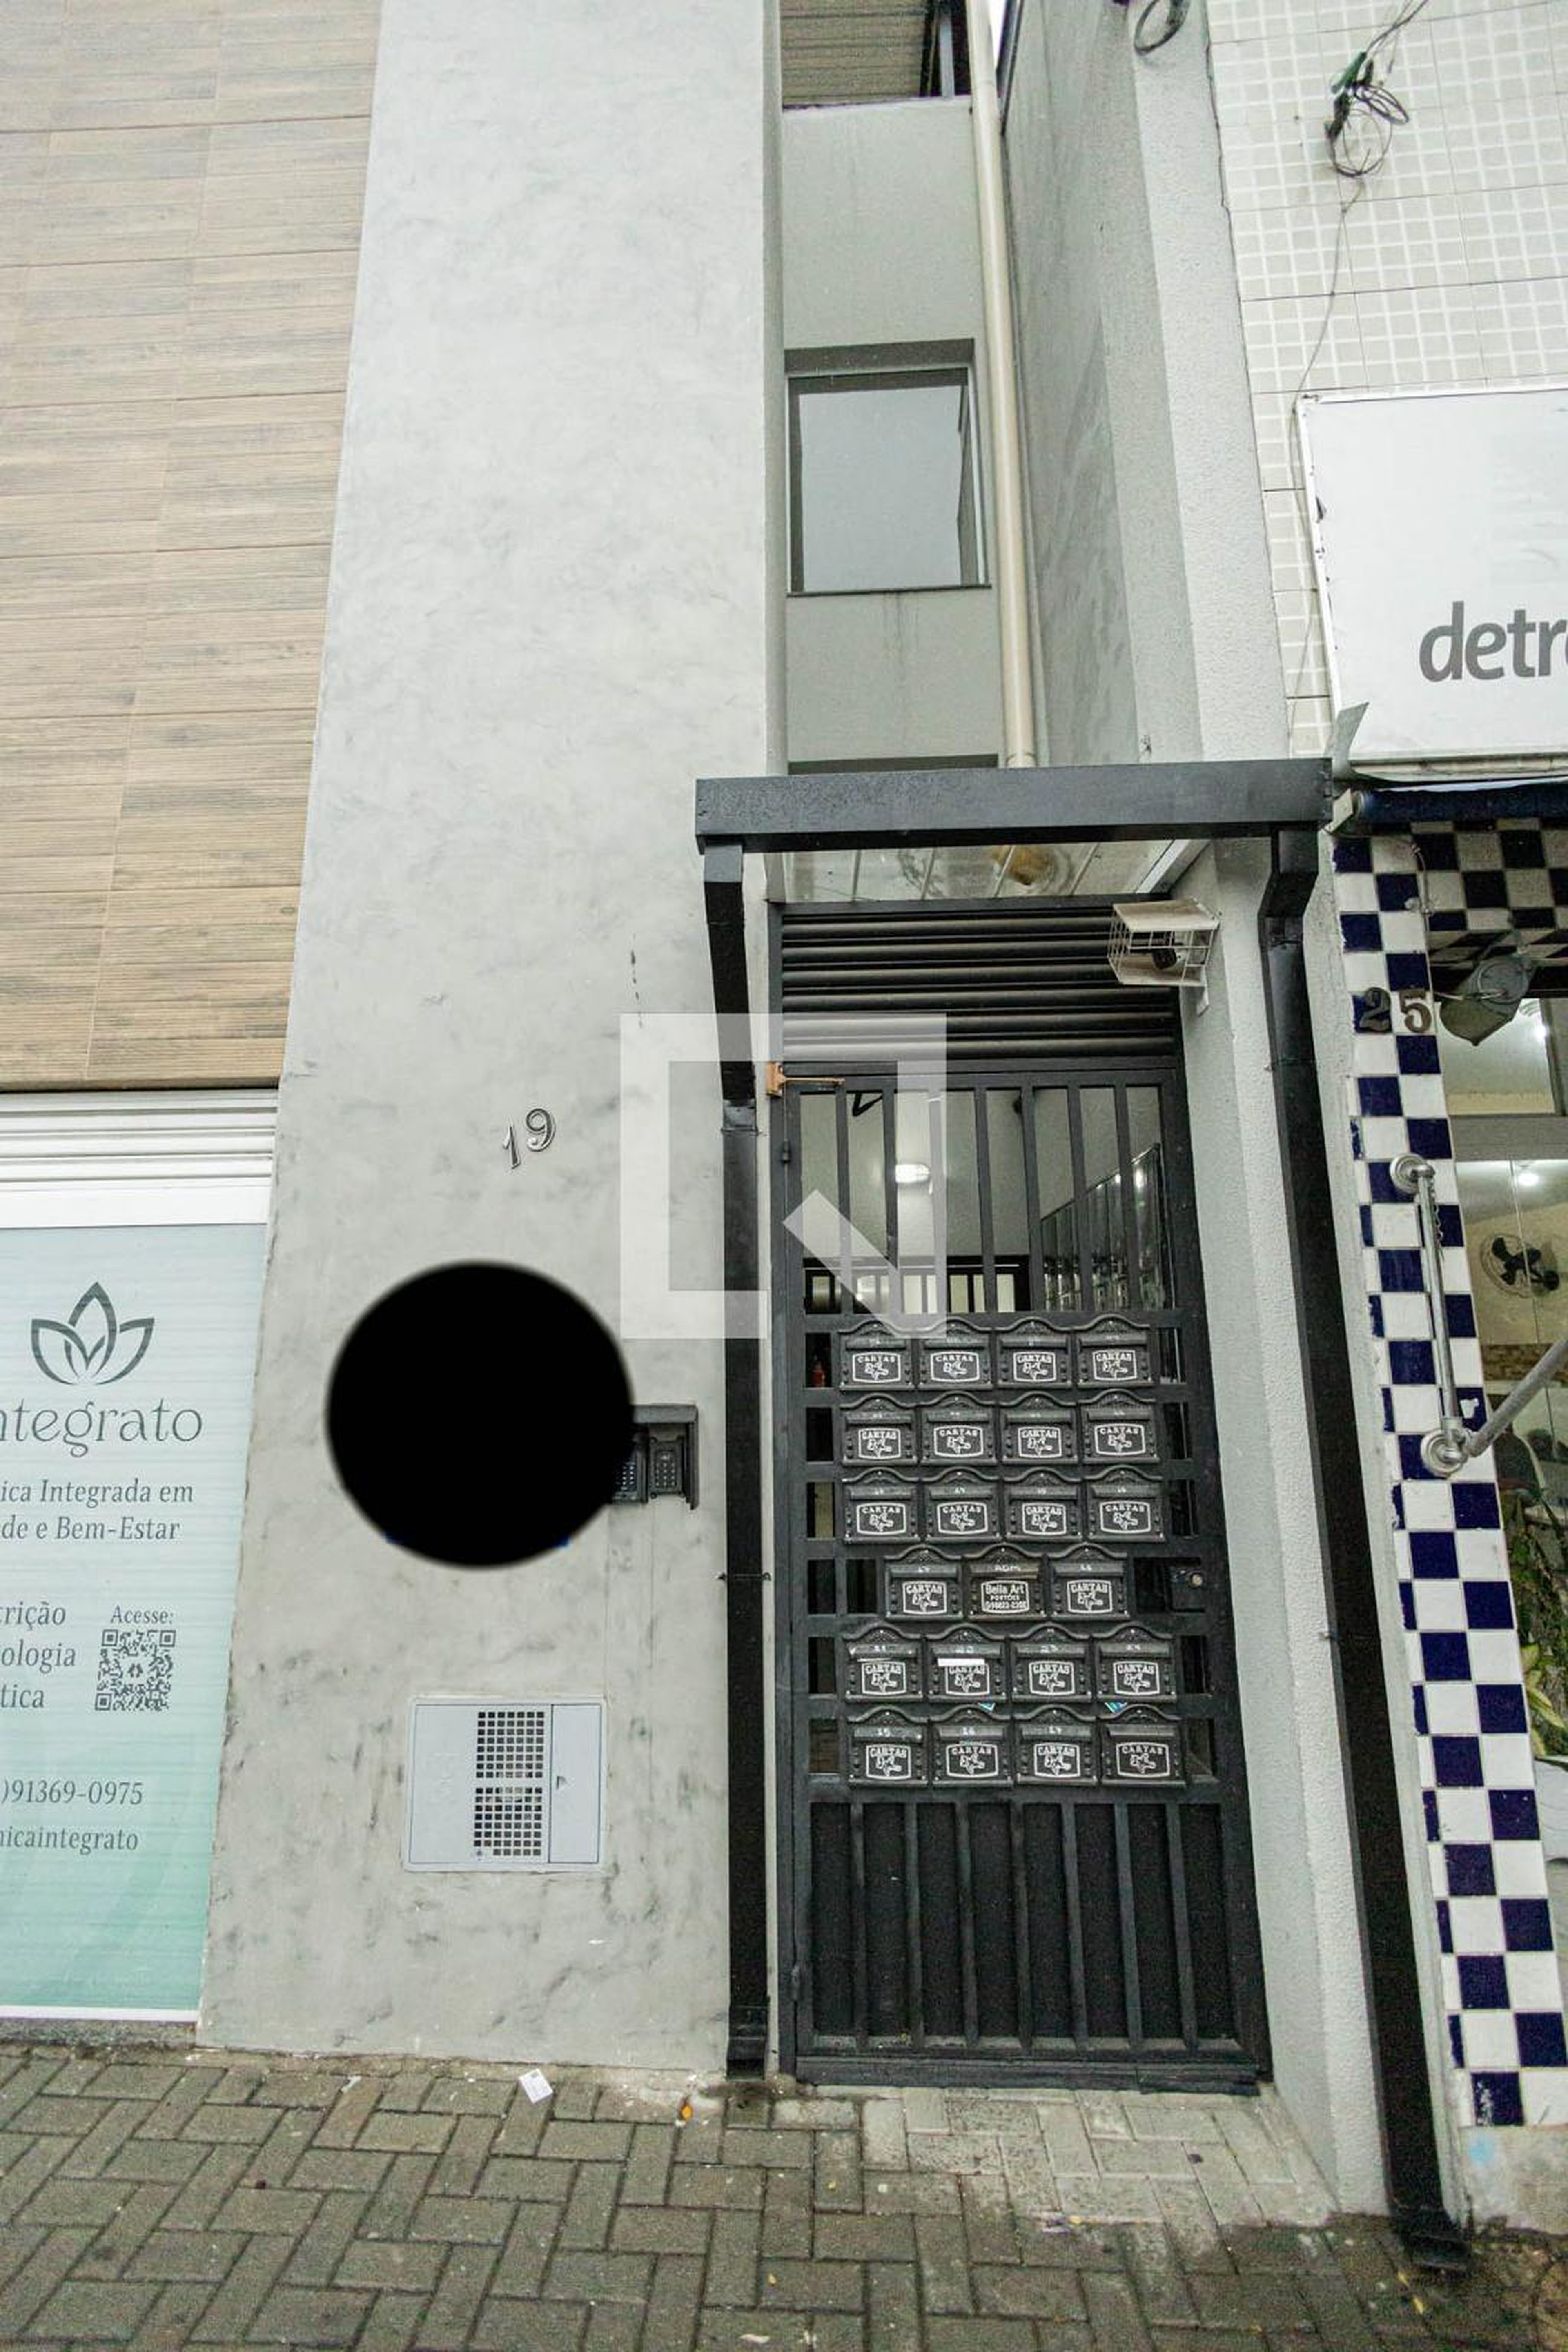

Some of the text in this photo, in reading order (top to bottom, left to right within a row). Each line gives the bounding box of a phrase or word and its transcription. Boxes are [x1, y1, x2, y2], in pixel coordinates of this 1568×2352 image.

[1419, 601, 1568, 682] detr
[1359, 987, 1432, 1033] 25
[503, 1108, 556, 1169] 19
[40, 1478, 151, 1508] Integrada
[160, 1486, 194, 1502] em
[36, 1523, 48, 1539] e
[56, 1516, 180, 1539] Bem-Estar
[110, 1605, 174, 1624] Acesse:
[1, 1639, 76, 1674] ologia
[0, 1684, 45, 1708] tica
